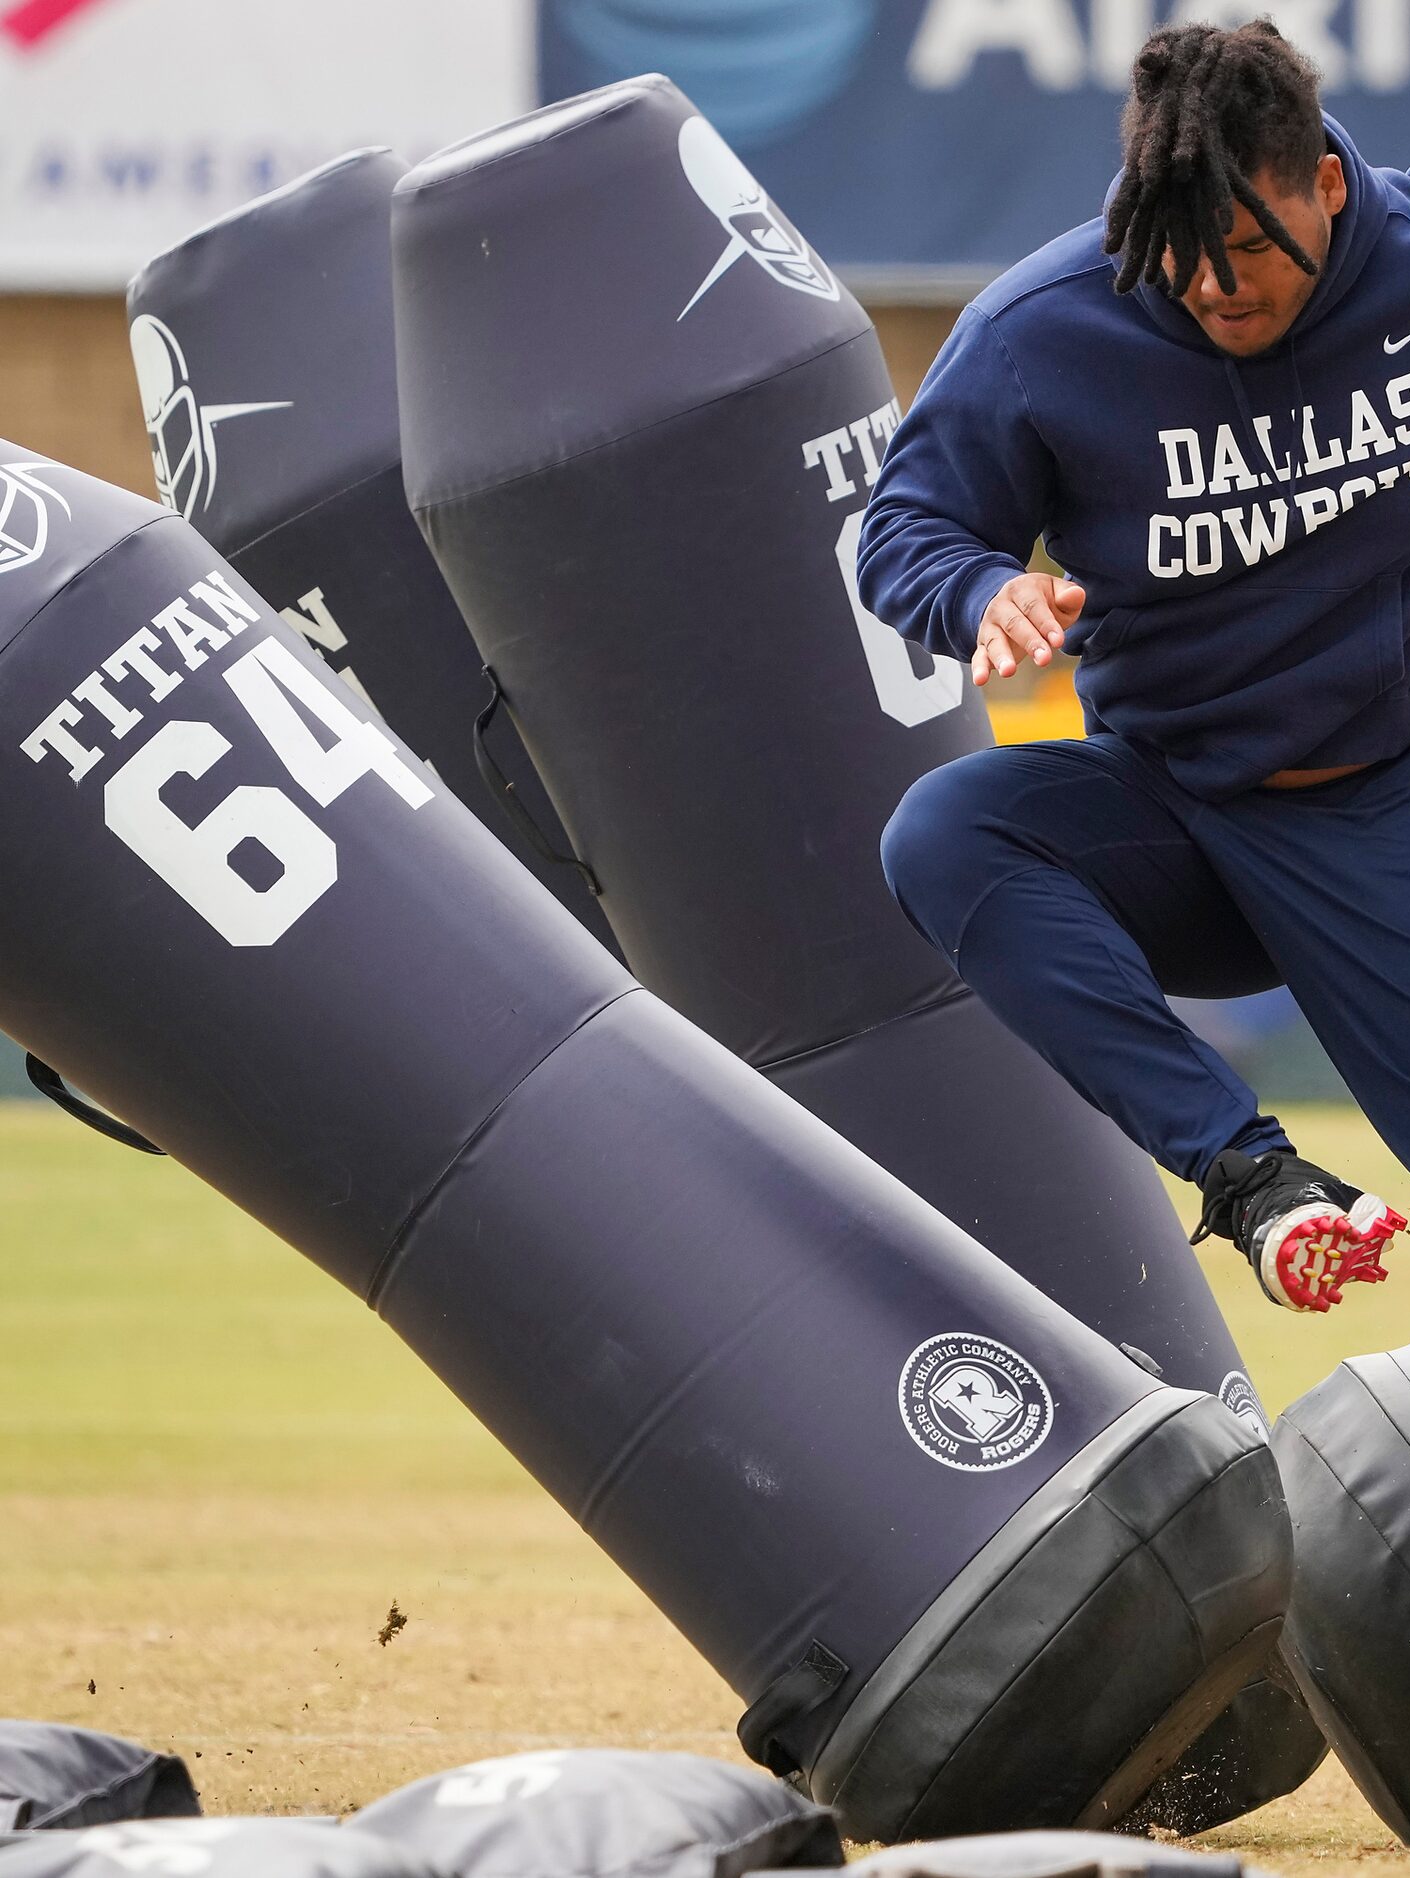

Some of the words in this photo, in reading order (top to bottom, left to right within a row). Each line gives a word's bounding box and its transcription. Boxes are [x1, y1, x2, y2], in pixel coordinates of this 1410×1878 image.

[801, 396, 903, 502] TIT
[19, 570, 262, 784] TITAN
[104, 635, 437, 947] 64
[911, 1344, 959, 1400] ATHLETIC
[961, 1343, 1032, 1386] COMPANY
[913, 1403, 960, 1455] ROGERS
[980, 1402, 1041, 1460] ROGERS
